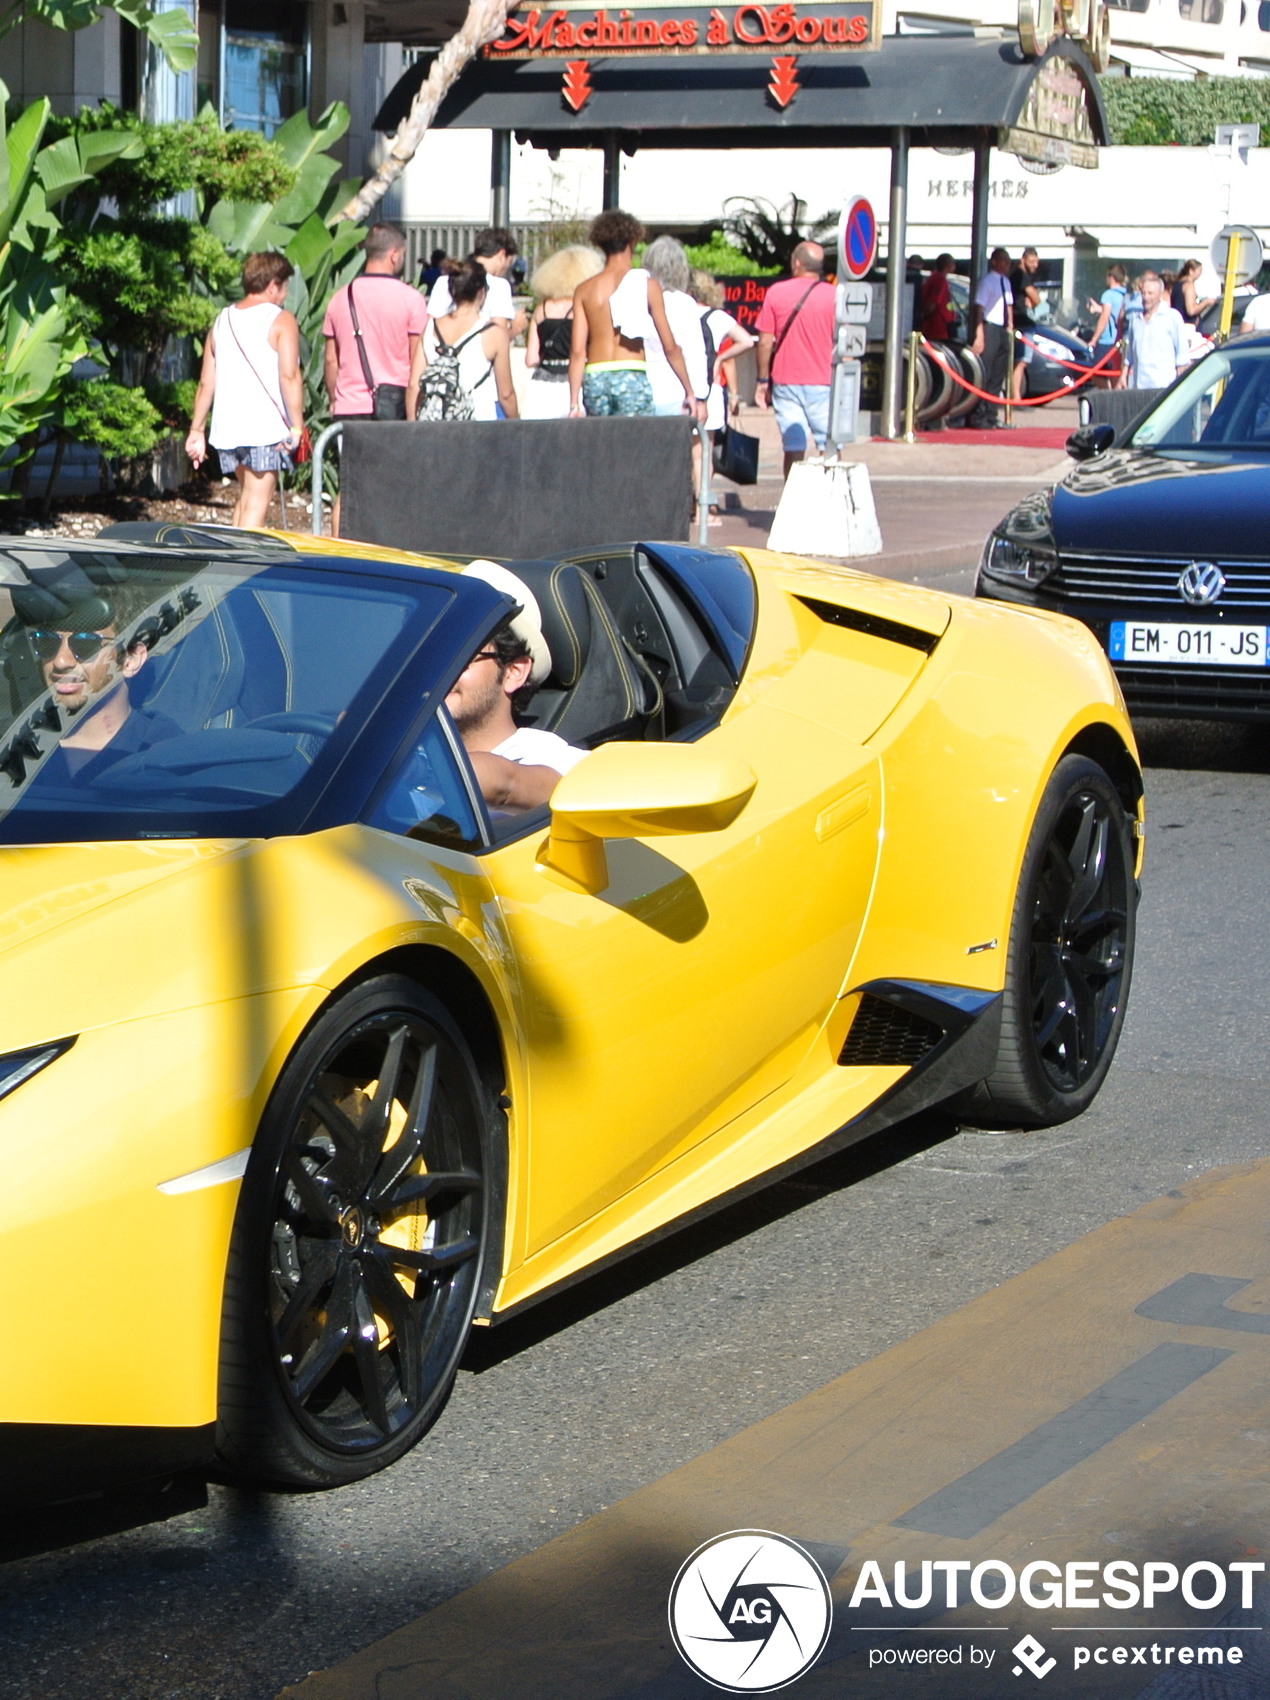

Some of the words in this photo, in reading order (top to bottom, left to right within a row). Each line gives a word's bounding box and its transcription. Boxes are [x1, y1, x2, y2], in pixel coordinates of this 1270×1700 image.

[493, 7, 697, 49] Machines
[706, 9, 729, 45] à
[733, 4, 869, 45] Sous
